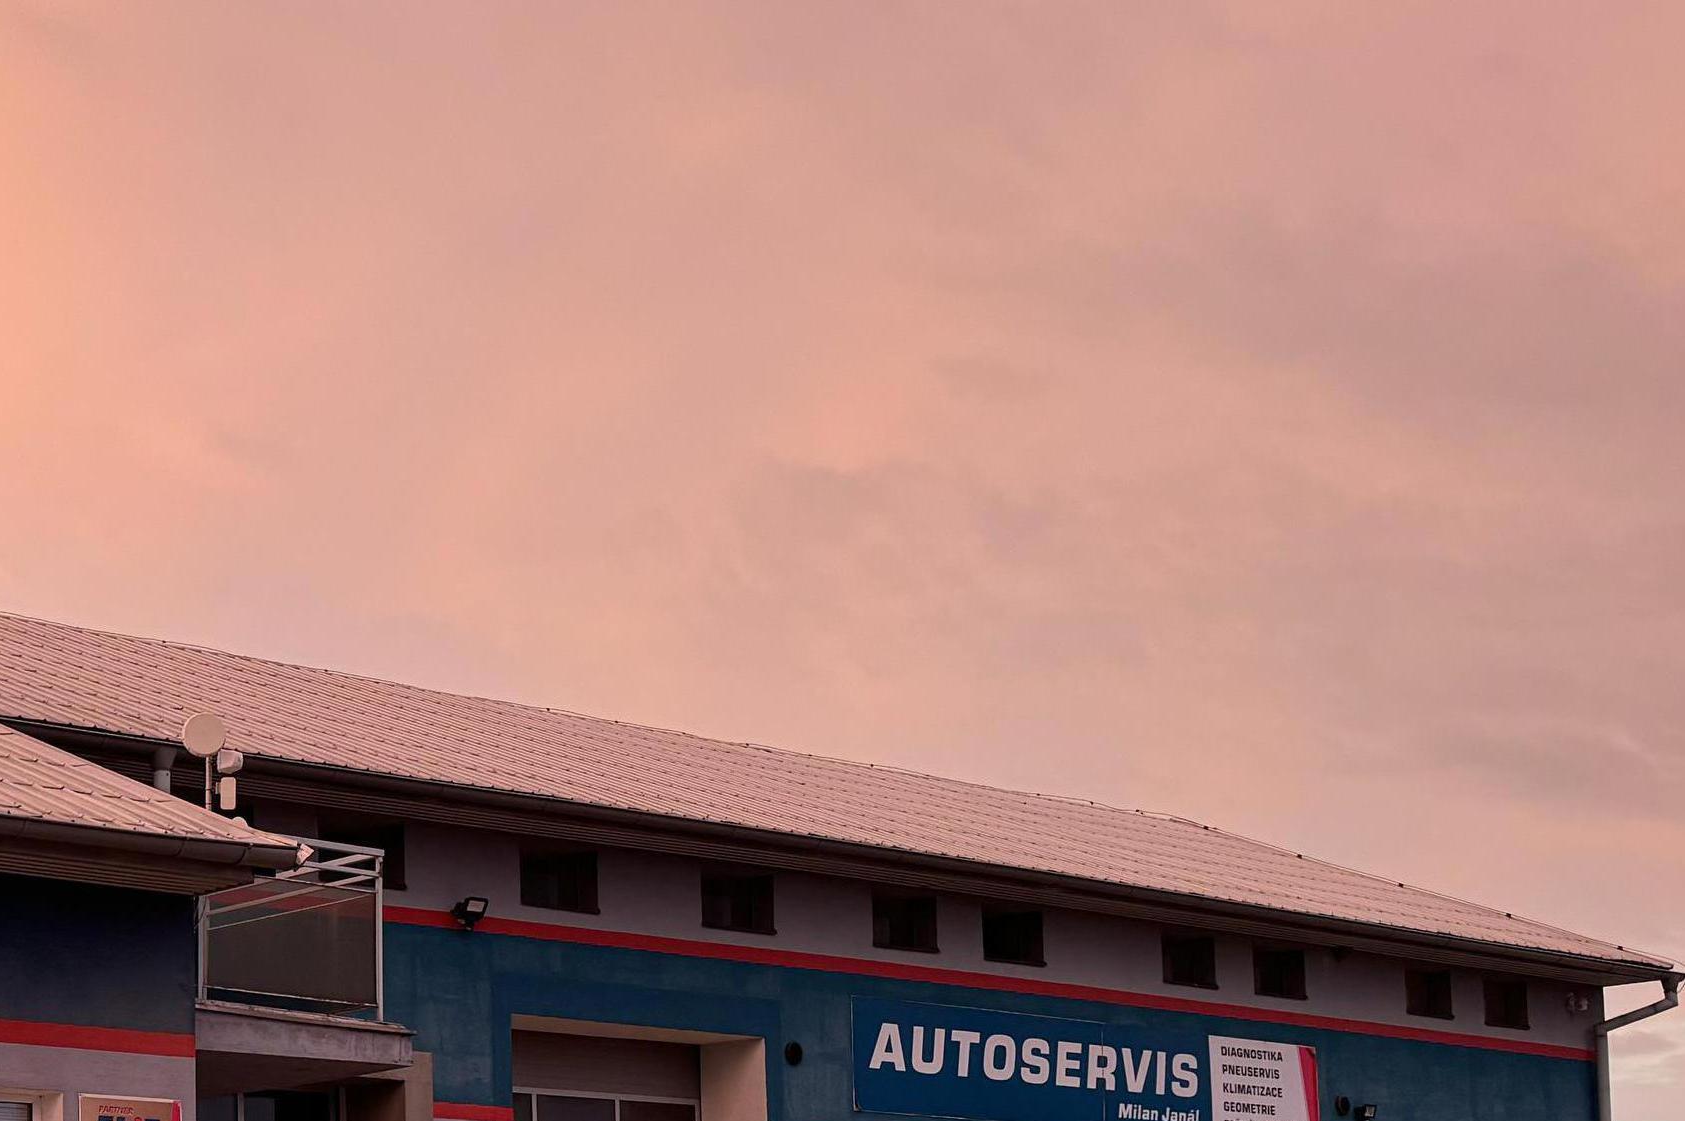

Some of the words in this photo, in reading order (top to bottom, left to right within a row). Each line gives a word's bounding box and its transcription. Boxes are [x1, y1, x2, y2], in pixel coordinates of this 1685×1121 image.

[868, 1022, 1199, 1098] AUTOSERVIS
[1220, 1046, 1283, 1062] DIAGNOSTIKA
[1222, 1064, 1280, 1080] PNEUSERVIS
[1222, 1083, 1283, 1098] KLIMATIZACE
[1118, 1103, 1159, 1121] Milan
[1223, 1101, 1276, 1116] GEOMETRIE
